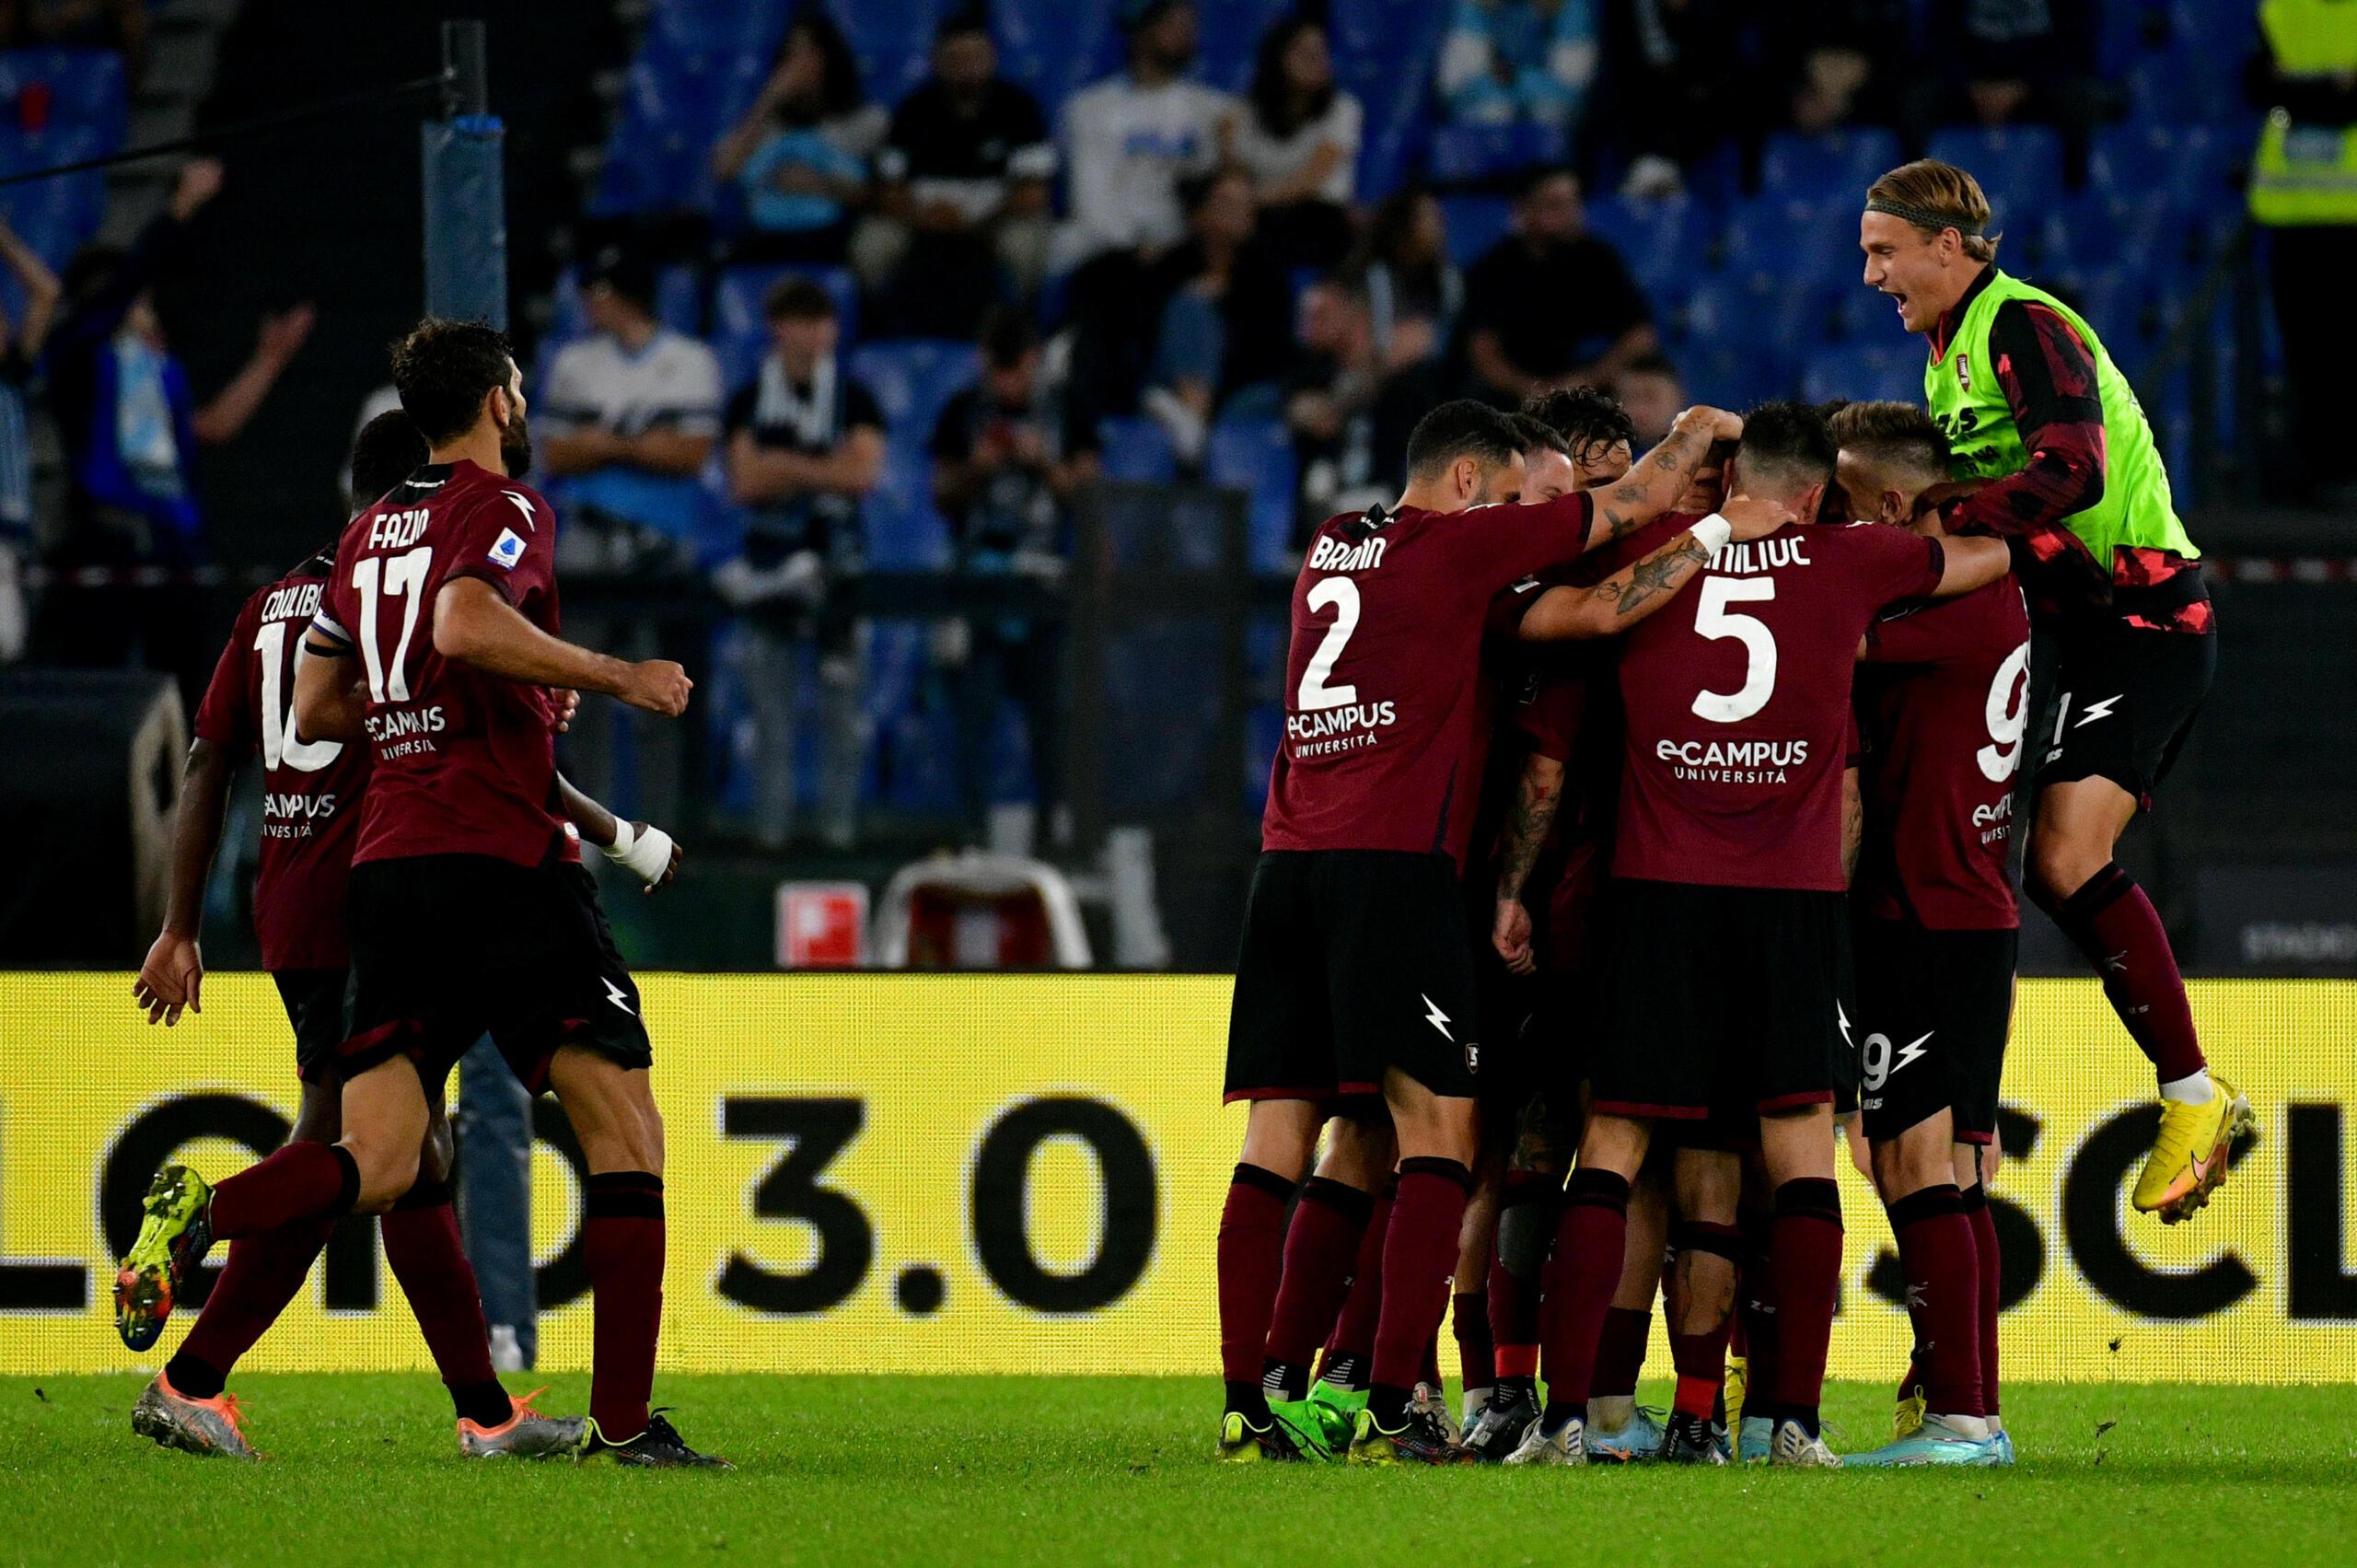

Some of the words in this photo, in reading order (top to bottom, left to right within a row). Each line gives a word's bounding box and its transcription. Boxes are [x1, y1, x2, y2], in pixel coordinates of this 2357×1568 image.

[368, 508, 430, 550] FAZIO
[1702, 535, 1811, 574] NILIUC
[353, 546, 433, 703] 17
[1297, 575, 1361, 711] 2
[1691, 576, 1777, 723] 5
[1656, 739, 1808, 767] eCAMPUS
[1976, 640, 2031, 783] 9
[1674, 766, 1787, 784] UNIVERSITÀ
[1863, 1032, 1892, 1092] 9
[714, 1094, 1162, 1318] 3.0
